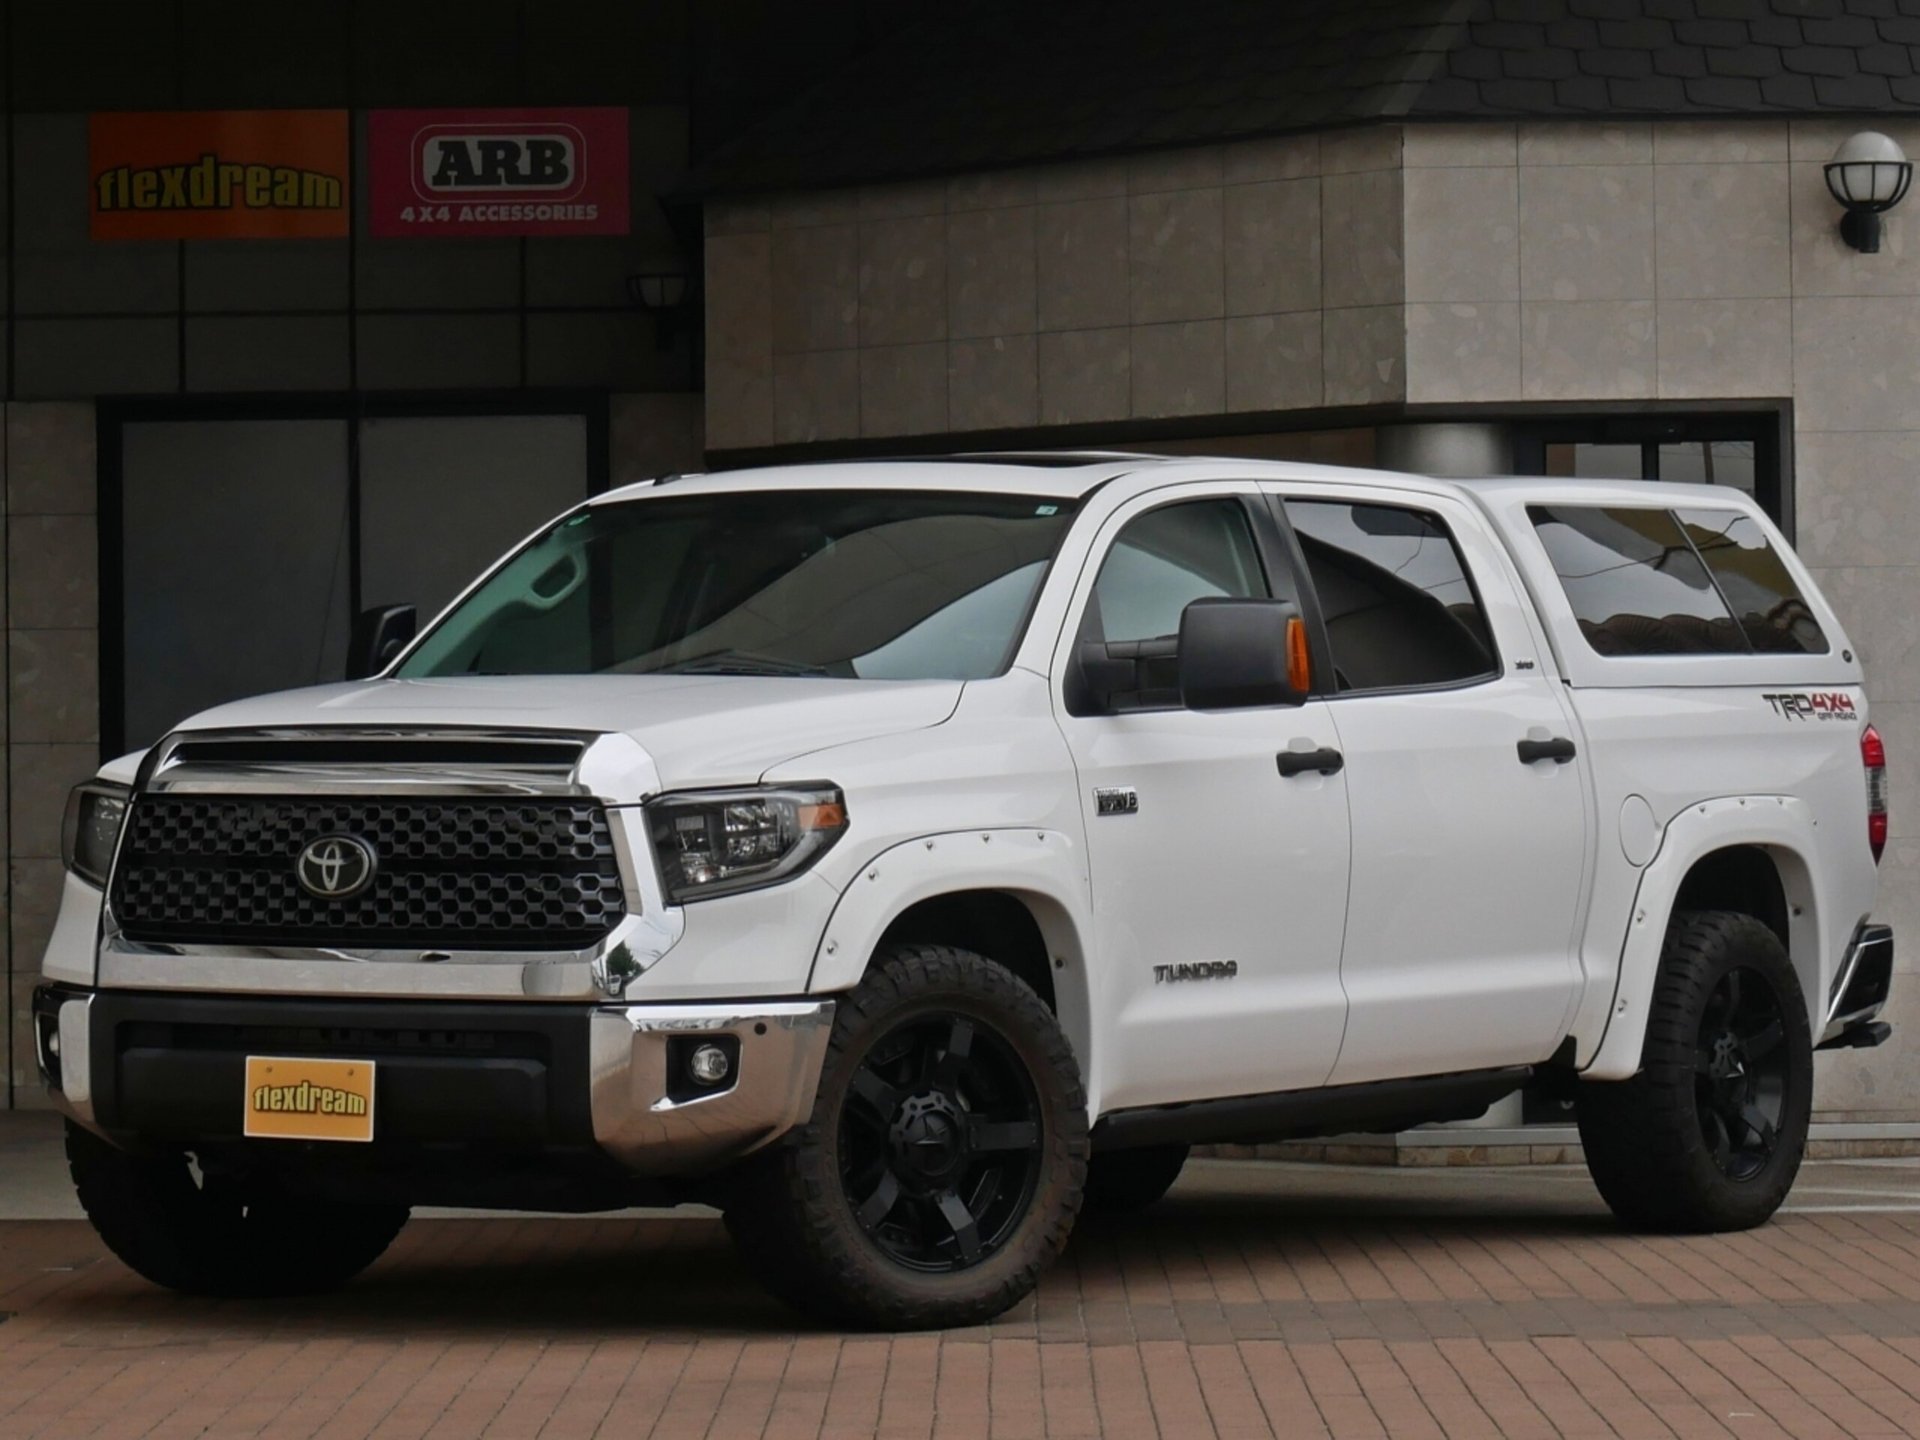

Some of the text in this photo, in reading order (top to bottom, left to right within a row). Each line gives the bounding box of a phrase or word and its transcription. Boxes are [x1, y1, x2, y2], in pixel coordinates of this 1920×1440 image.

[431, 139, 570, 188] ARB
[97, 154, 342, 211] flexdream
[458, 204, 598, 222] ACCESSORIES
[1153, 960, 1237, 983] TUNDRA
[254, 1080, 366, 1115] flexdream
